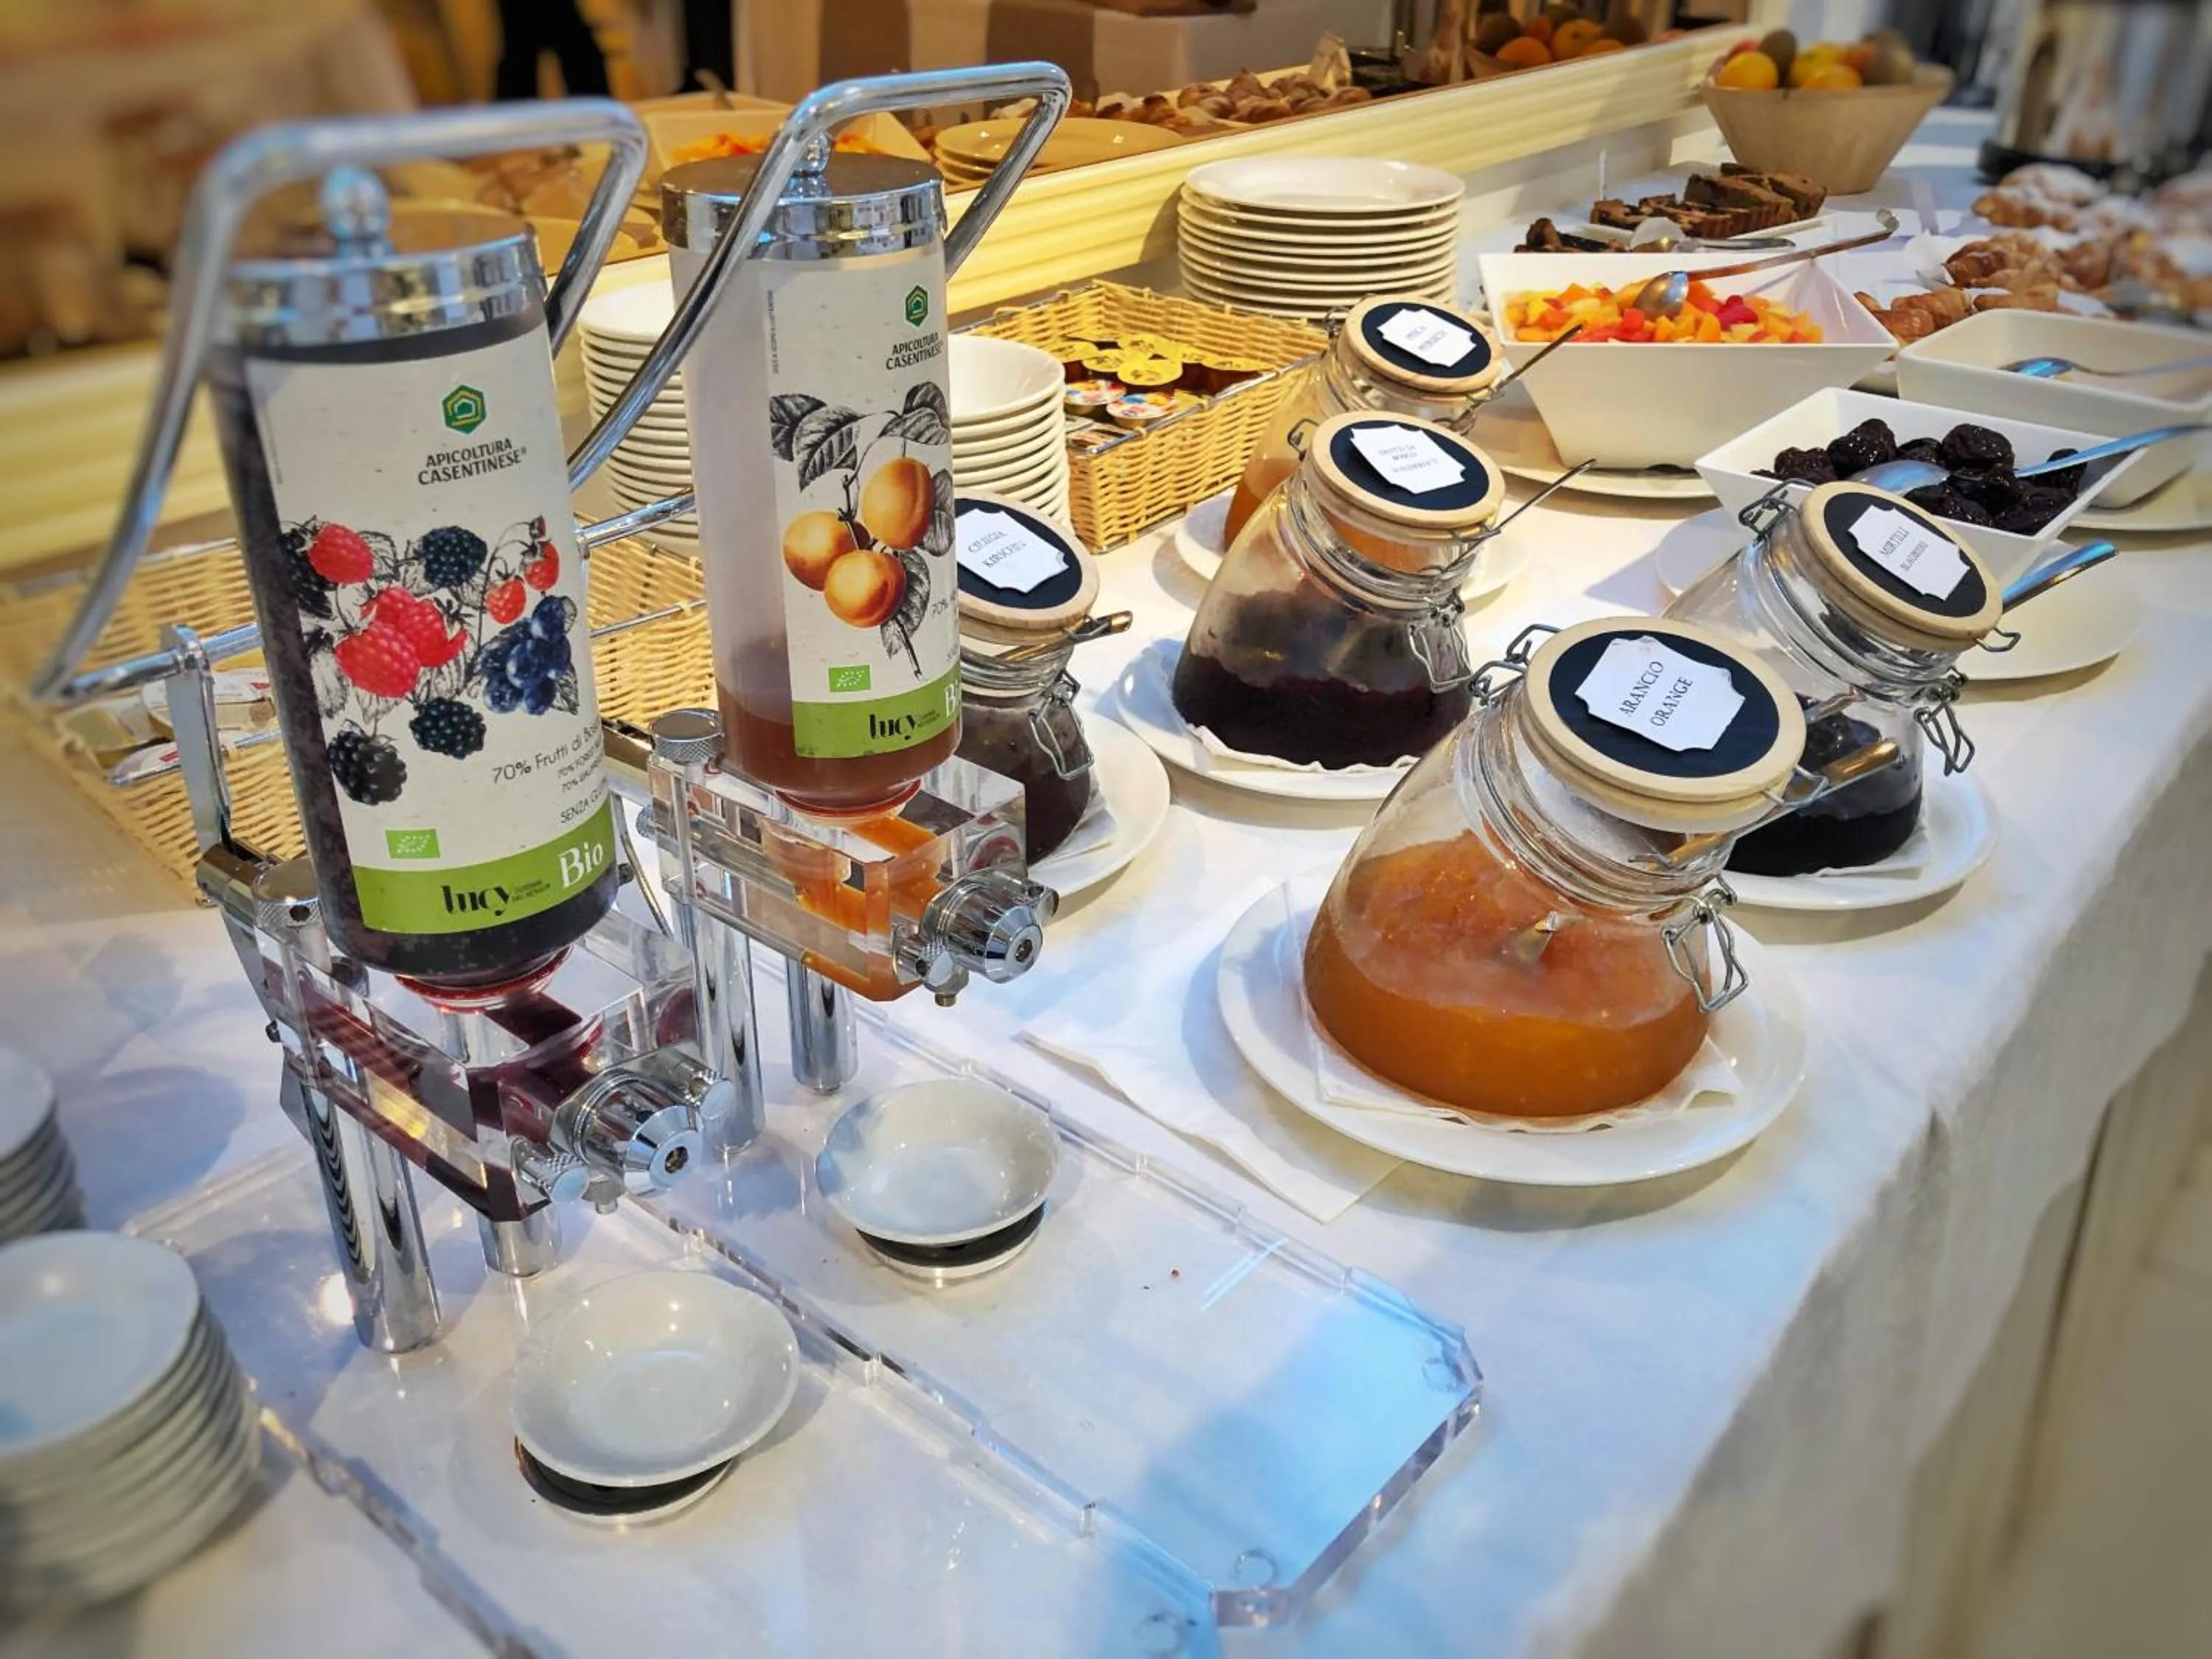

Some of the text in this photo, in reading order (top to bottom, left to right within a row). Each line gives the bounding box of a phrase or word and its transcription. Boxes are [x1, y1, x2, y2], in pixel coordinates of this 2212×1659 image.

[417, 449, 521, 485] CASENTINESE
[425, 438, 512, 468] APICOLTURA
[1618, 661, 1665, 717] ARANCIO
[1649, 677, 1694, 727] ORANGE
[869, 713, 917, 740] lucy
[491, 760, 532, 784] 70%
[535, 743, 568, 771] Frutti
[560, 798, 589, 824] SENZA
[441, 884, 510, 917] lucy
[557, 841, 604, 888] Bio
